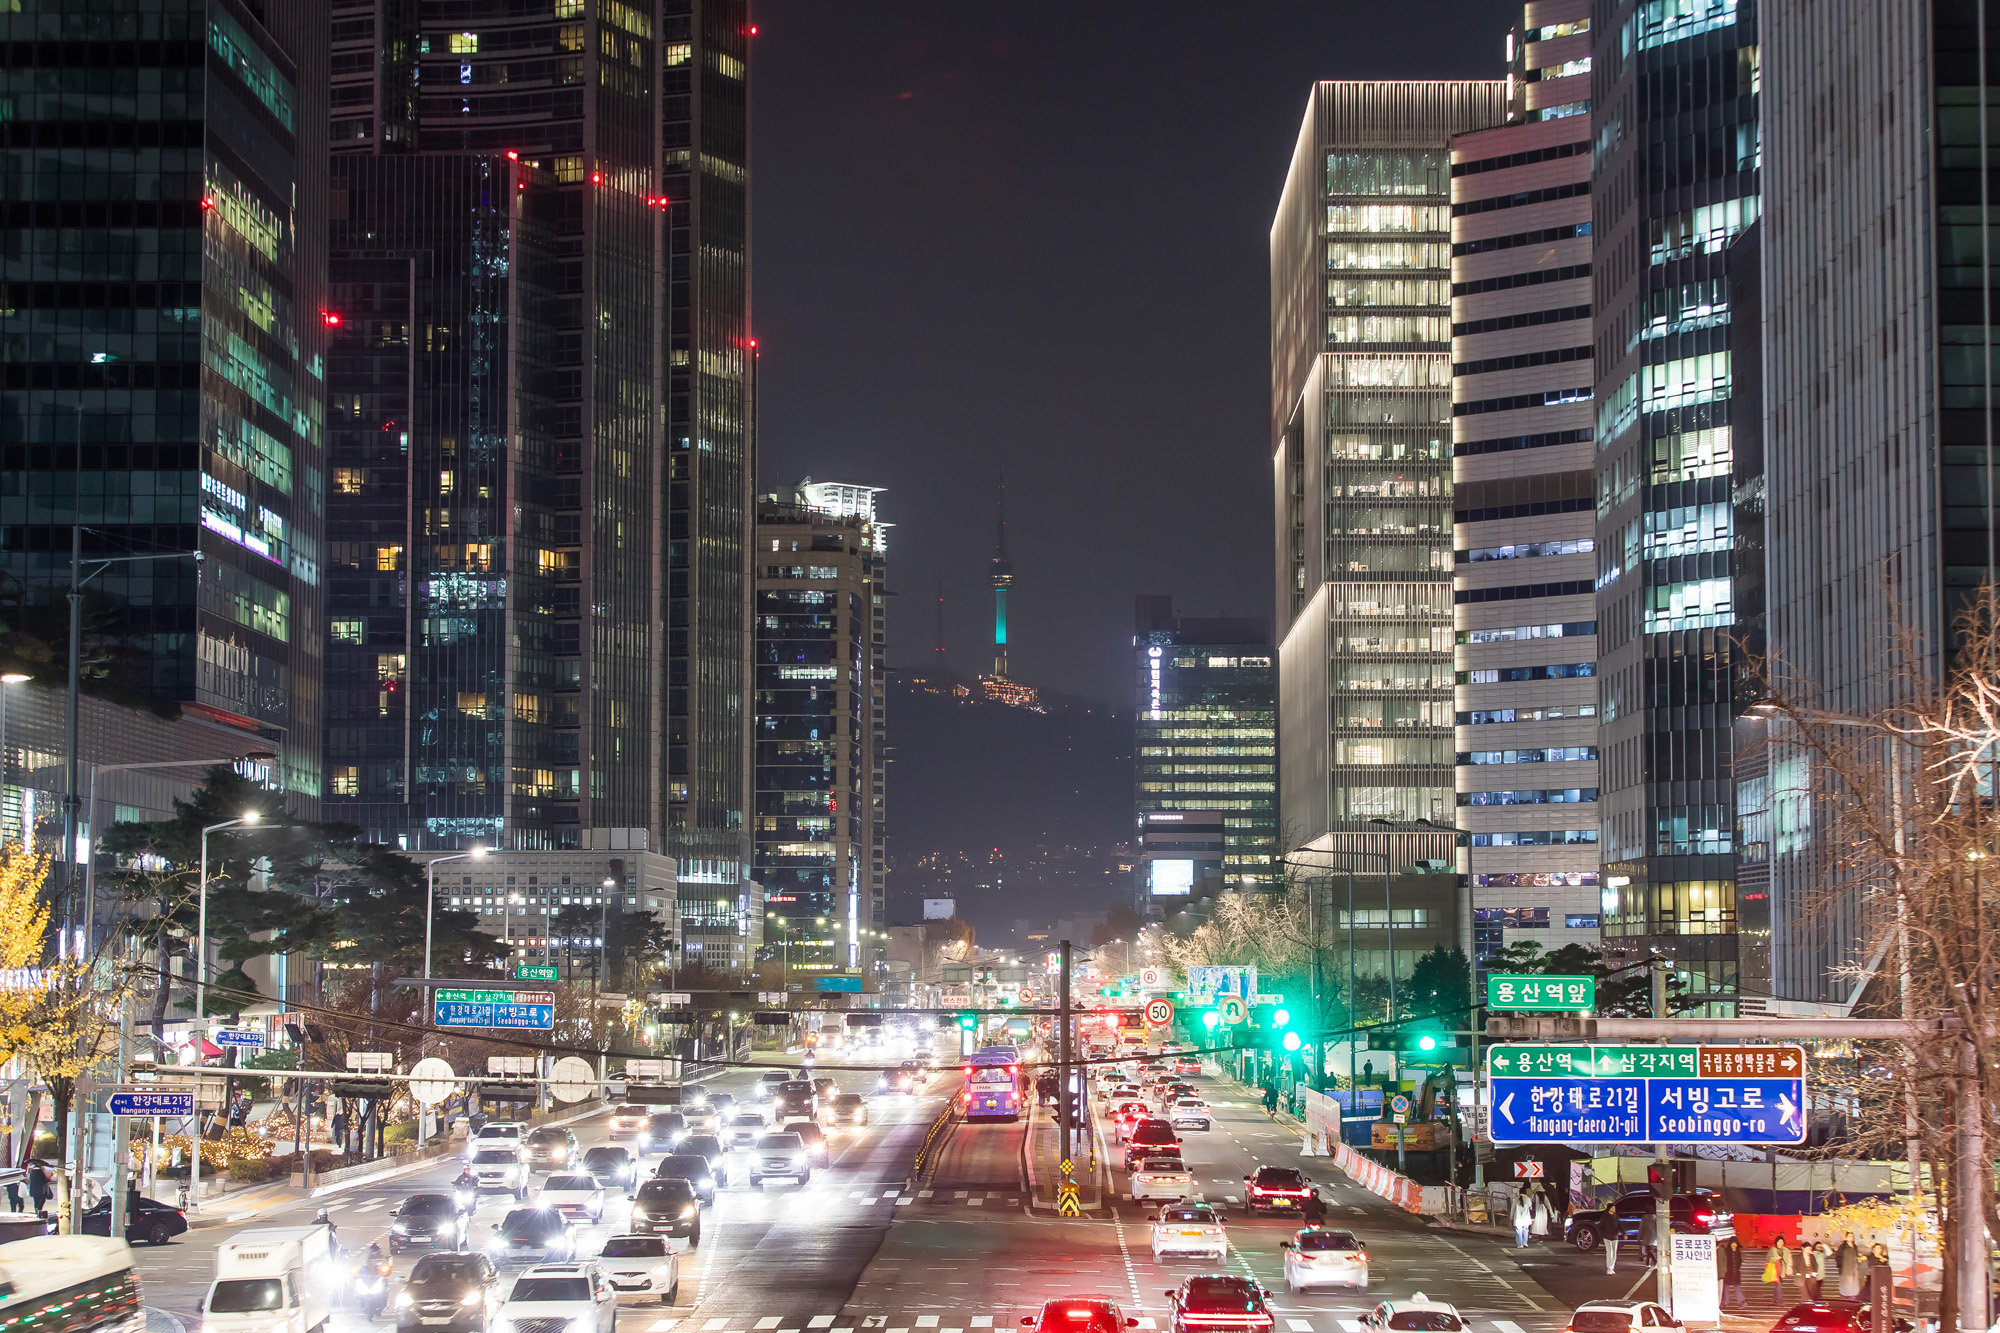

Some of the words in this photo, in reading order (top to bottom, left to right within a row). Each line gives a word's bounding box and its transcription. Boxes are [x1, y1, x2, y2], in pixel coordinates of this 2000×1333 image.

[520, 967, 554, 978] 용산역앞
[445, 992, 467, 1000] 용산역
[1496, 982, 1587, 1004] 용산역앞
[498, 1007, 538, 1017] 서빙고로
[1152, 1005, 1167, 1019] 50
[1516, 1053, 1573, 1073] 용산역
[1620, 1053, 1696, 1073] 삼각지역
[1702, 1053, 1777, 1073] 국립중앙박물관
[132, 1096, 192, 1106] 한강대로21길
[1659, 1086, 1765, 1114] 서빙고로
[120, 1107, 172, 1116] Hangang-daero
[172, 1107, 192, 1115] 21-gil
[1530, 1115, 1607, 1137] Hangang-daero
[1608, 1115, 1639, 1137] 21-gil
[1659, 1115, 1766, 1137] Seobinggo-ro
[1675, 1239, 1712, 1250] 도로포장
[1675, 1250, 1712, 1261] 공사안내
